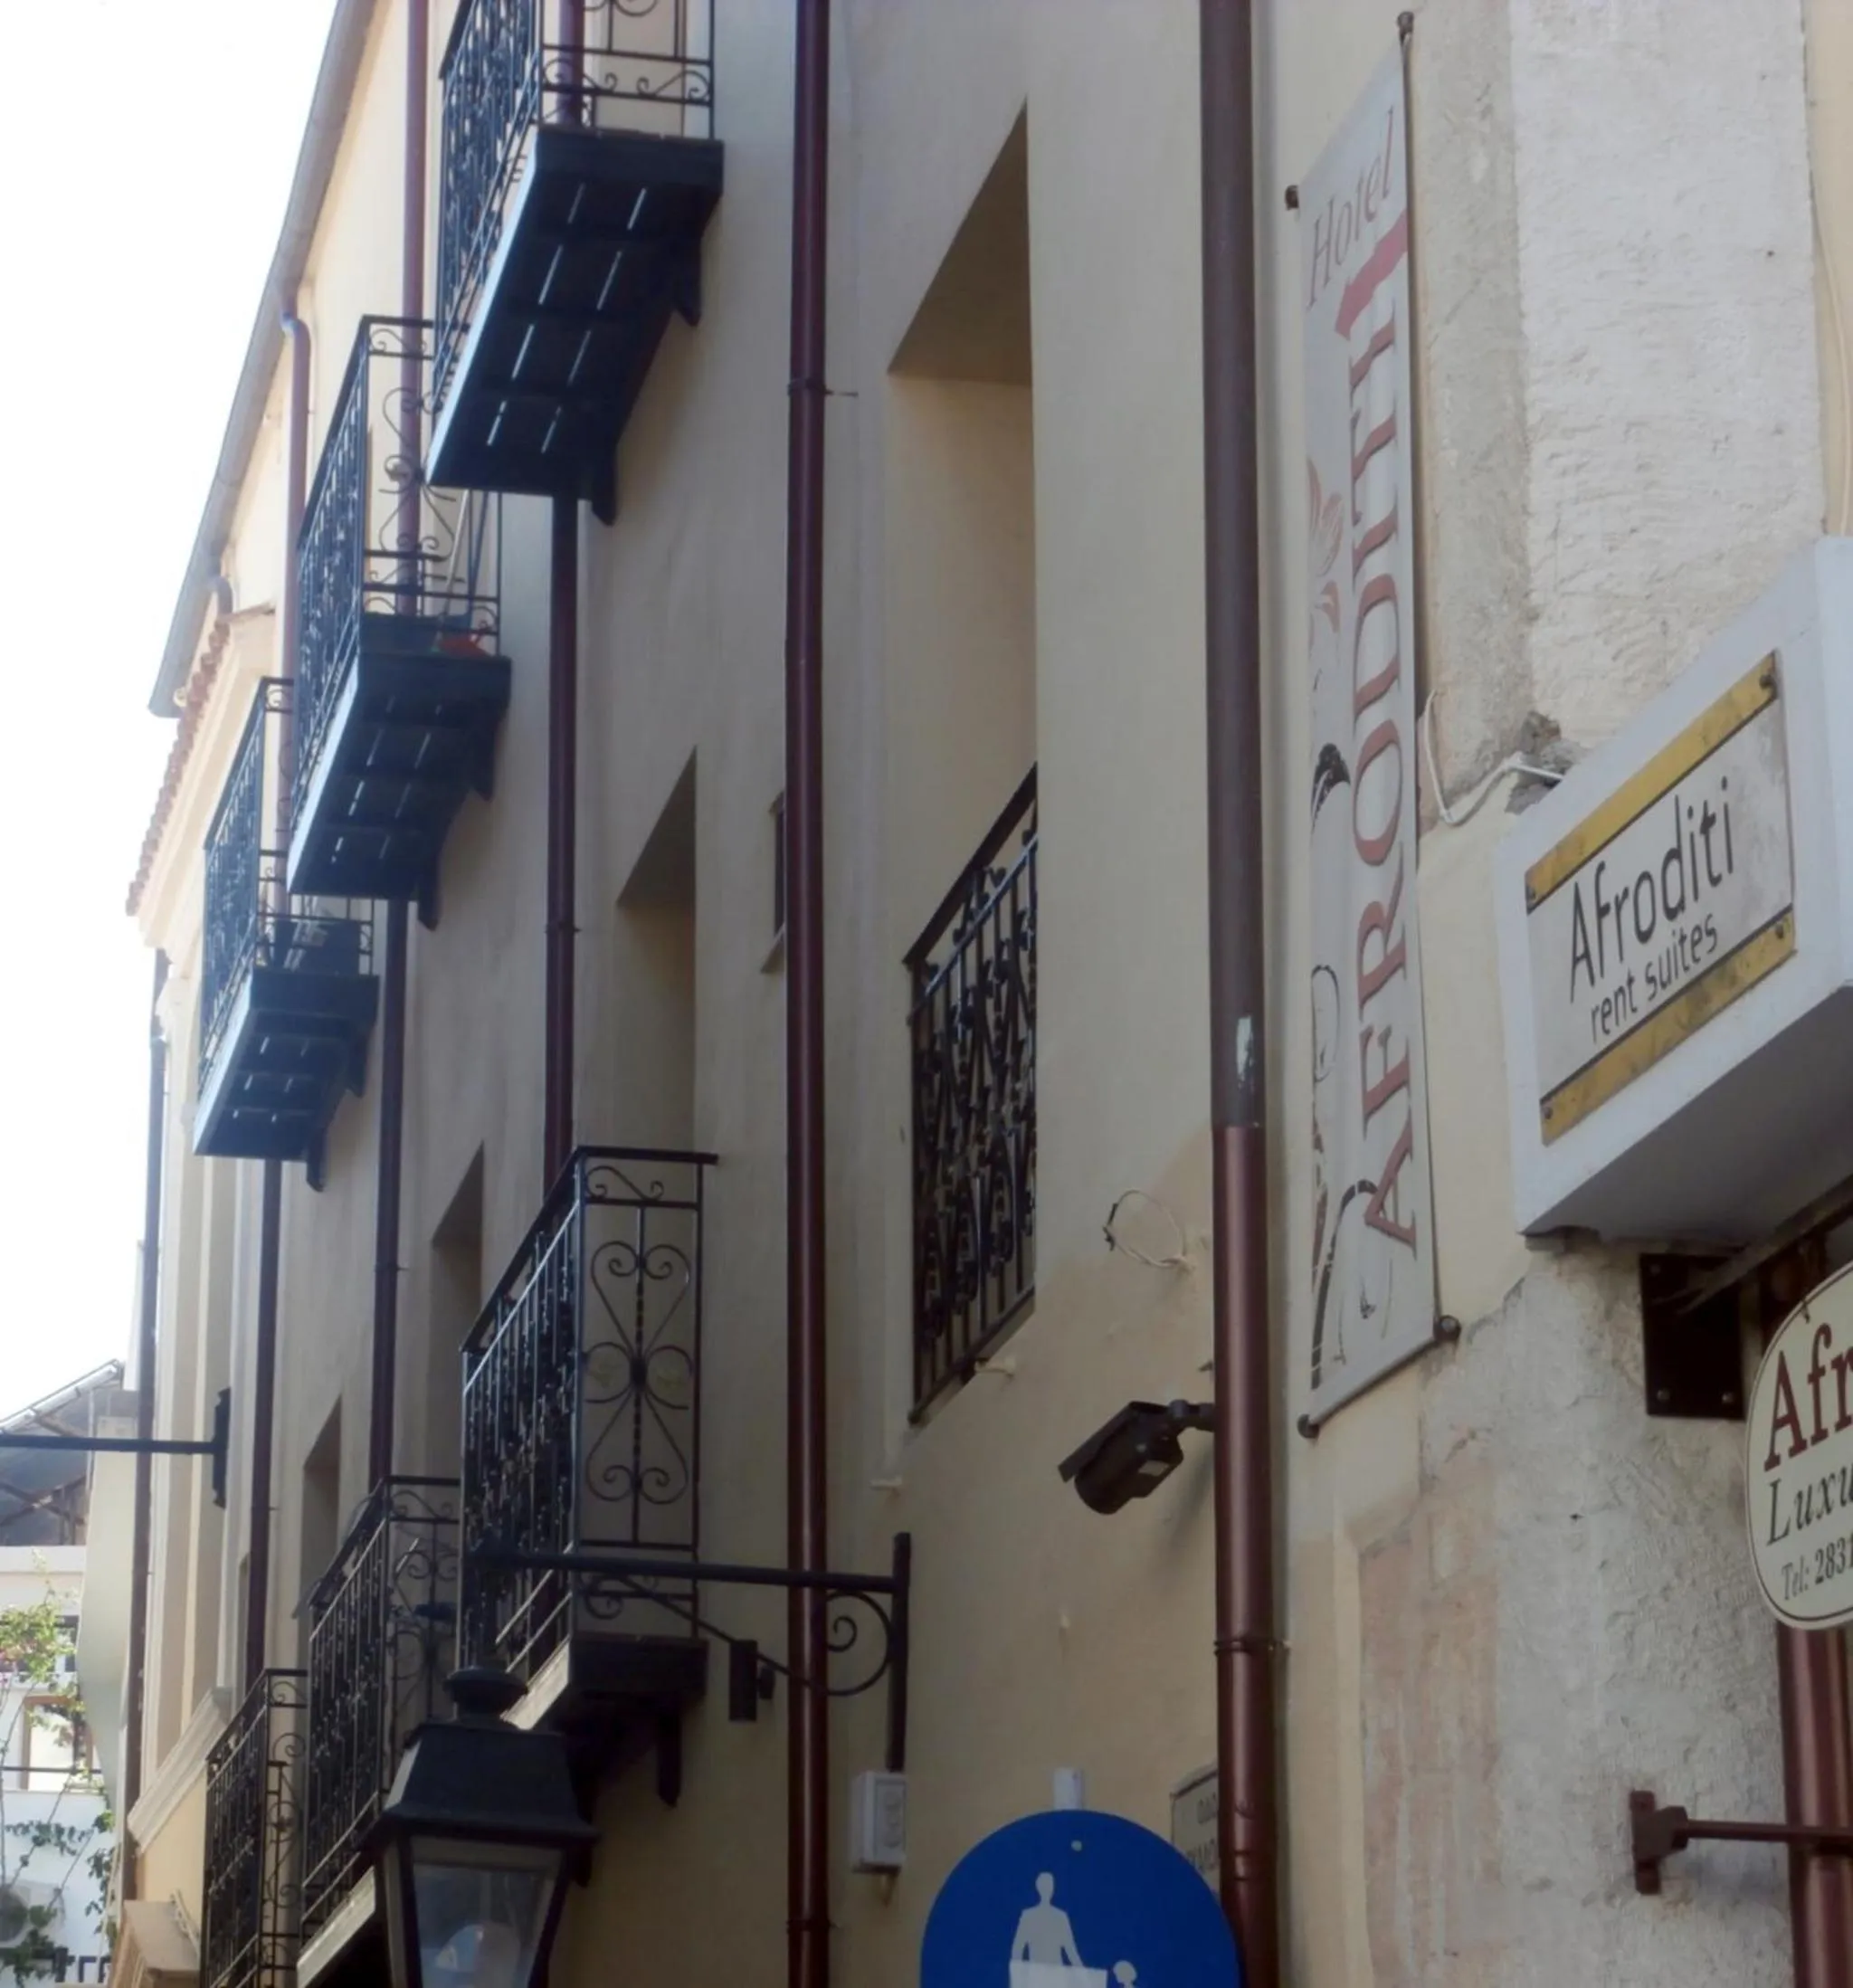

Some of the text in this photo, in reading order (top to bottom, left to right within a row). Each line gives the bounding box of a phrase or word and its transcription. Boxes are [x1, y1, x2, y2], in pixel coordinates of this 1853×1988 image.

[1307, 104, 1394, 311] Hotel
[1348, 295, 1417, 1260] AFRODITI
[1570, 775, 1733, 1004] Afroditi
[1591, 913, 1718, 1043] rent suites
[1782, 1554, 1810, 1601] Tel:
